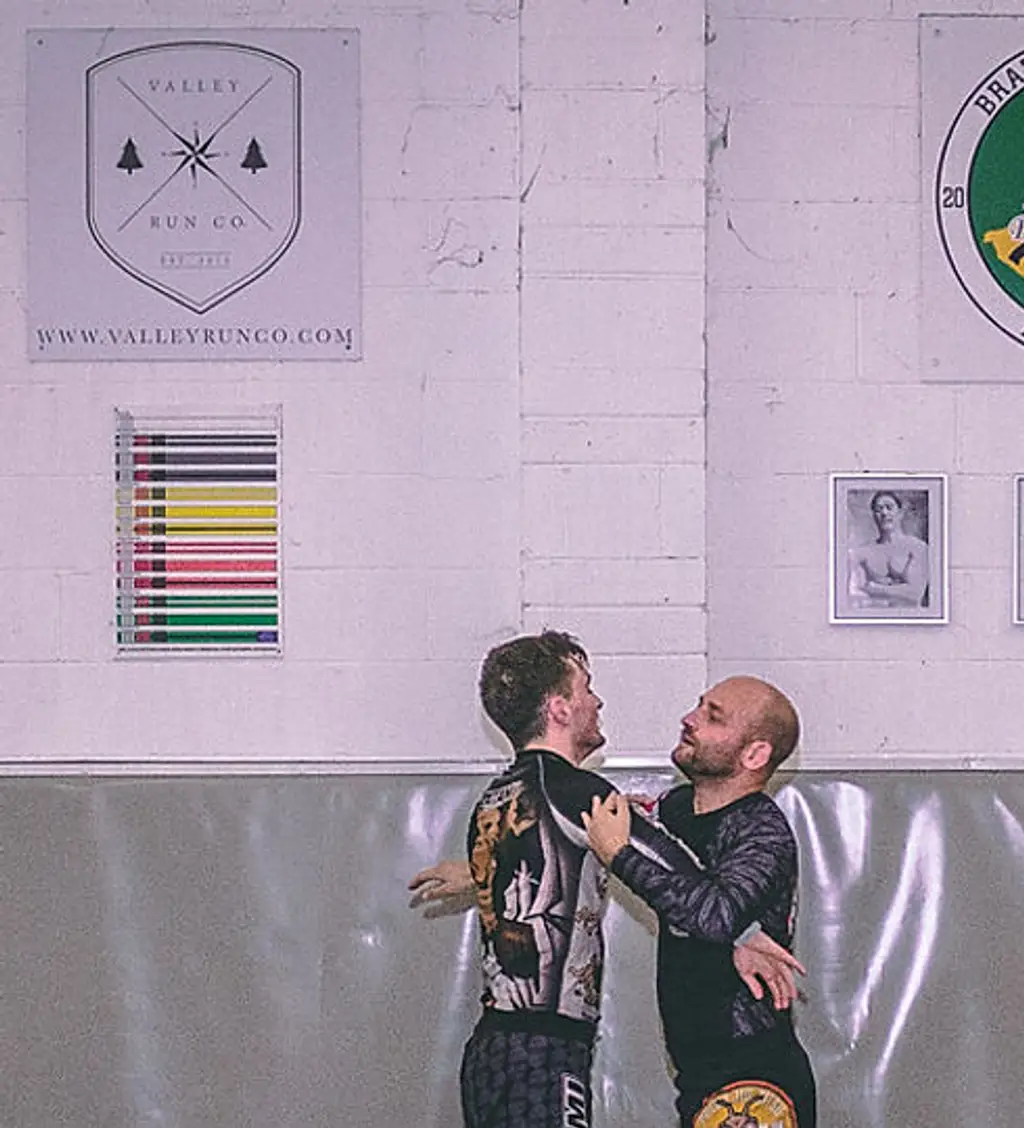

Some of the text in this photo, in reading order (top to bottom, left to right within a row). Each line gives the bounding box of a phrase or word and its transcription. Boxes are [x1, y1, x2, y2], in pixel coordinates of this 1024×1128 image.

[148, 79, 240, 93] VALLEY
[942, 186, 964, 208] 20
[150, 215, 198, 230] RUN
[36, 327, 352, 346] WWW.VALLEYRUNCO.COM
